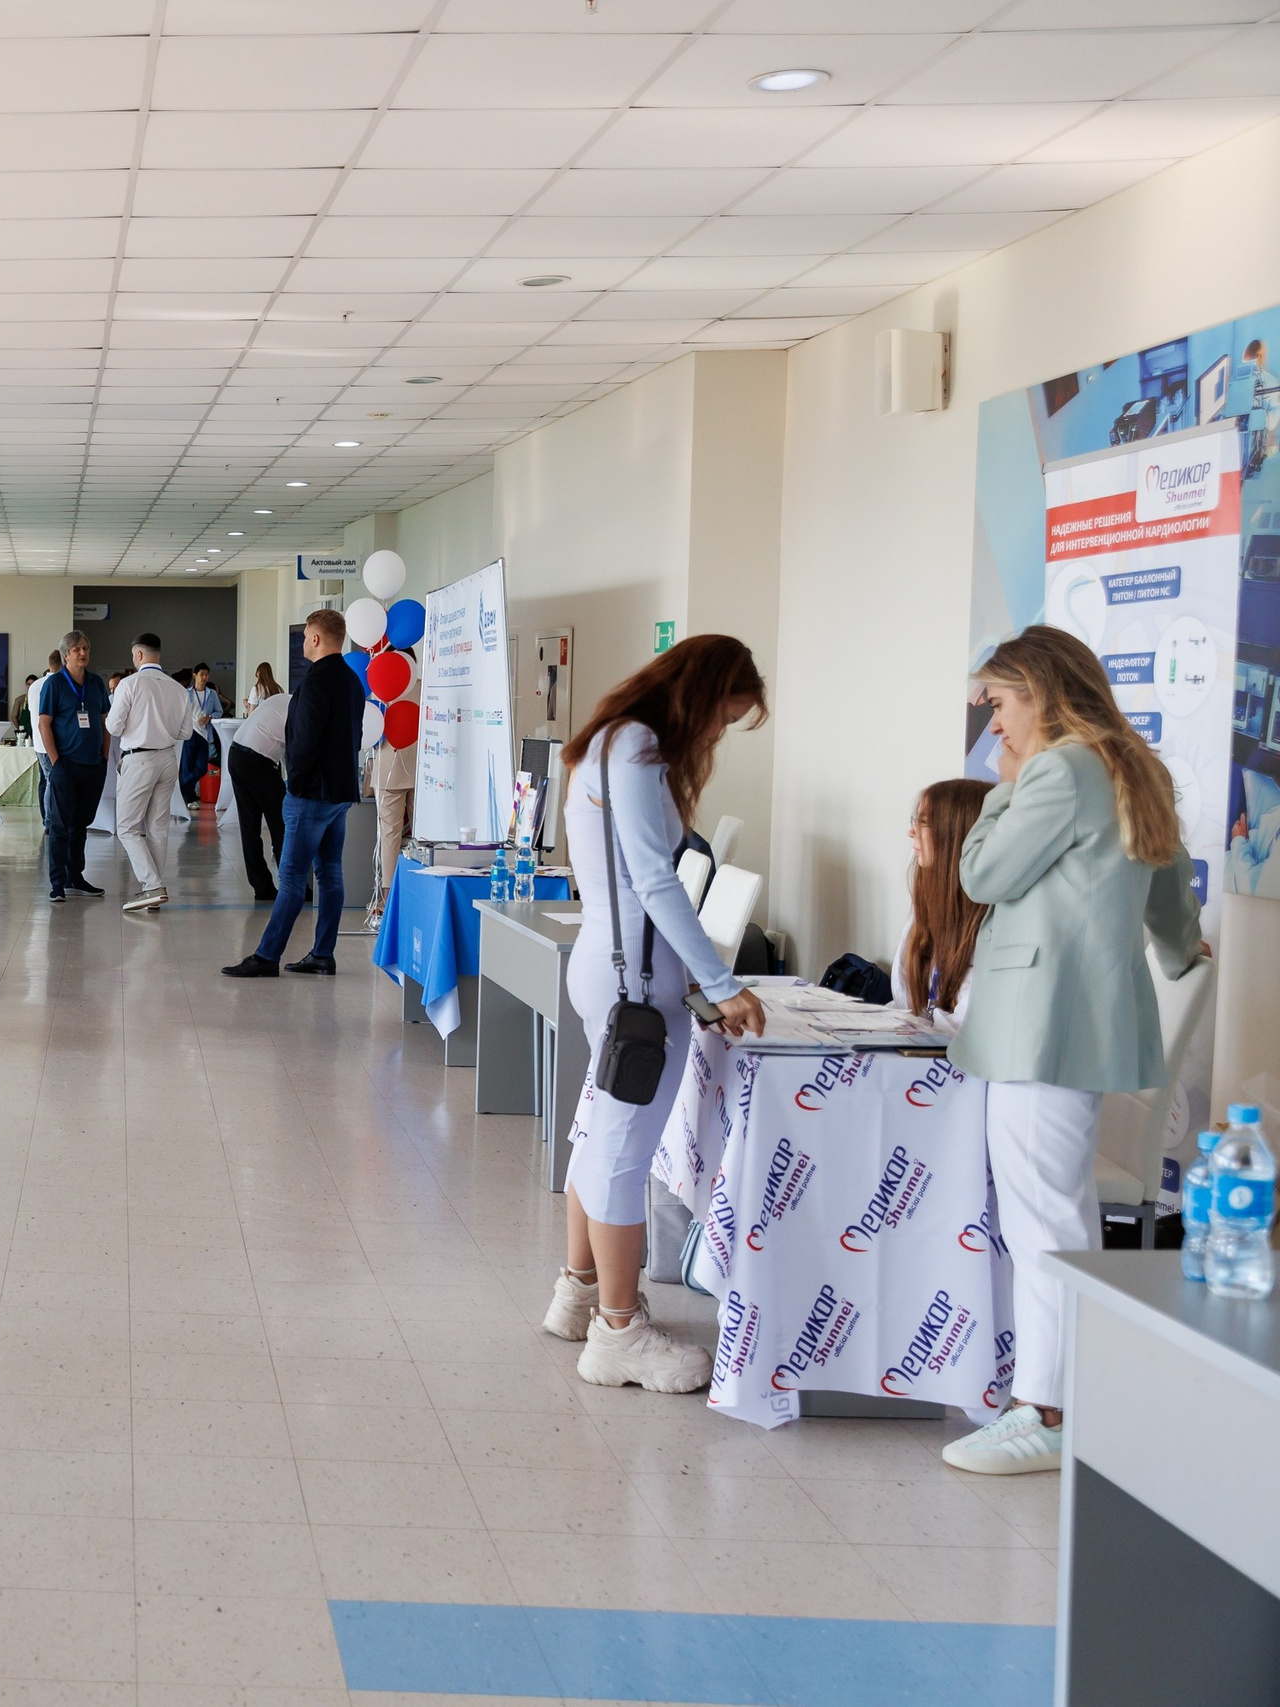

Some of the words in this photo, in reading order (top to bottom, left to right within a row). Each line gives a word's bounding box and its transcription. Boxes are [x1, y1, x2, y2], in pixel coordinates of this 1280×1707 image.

[1165, 485, 1206, 504] Shunmei
[1050, 542, 1065, 556] ДЛЯ
[1065, 526, 1144, 551] ИНТЕРВЕНЦИОННОЙ
[1145, 517, 1210, 537] КАРДИОЛОГИИ
[1051, 518, 1093, 537] НАДЕЖНЫЕ
[1094, 511, 1132, 528] РЕШЕНИЯ
[1108, 577, 1134, 588] КАТЕТЕР
[1134, 569, 1177, 585] БАЛЛОННЫЙ
[1111, 591, 1133, 602] ПИТОН
[1137, 588, 1160, 599] ПИТОН
[1160, 586, 1170, 596] NC
[1107, 657, 1150, 670] ИНДЕФЛЯТОР
[1116, 673, 1139, 682] ПОТОК
[772, 1150, 810, 1221] Shunmei
[790, 1187, 804, 1211] official
[802, 1163, 817, 1189] partner
[885, 1158, 926, 1229] Shunmei
[906, 1194, 920, 1220] official
[918, 1172, 933, 1198] partner
[730, 1301, 759, 1377] Shunmei
[749, 1338, 758, 1365] official
[813, 1298, 854, 1367] Shunmei
[834, 1333, 848, 1358] official
[846, 1311, 861, 1336] partner
[927, 1304, 970, 1375] Shunmei
[950, 1343, 964, 1367] official
[963, 1319, 978, 1345] partner
